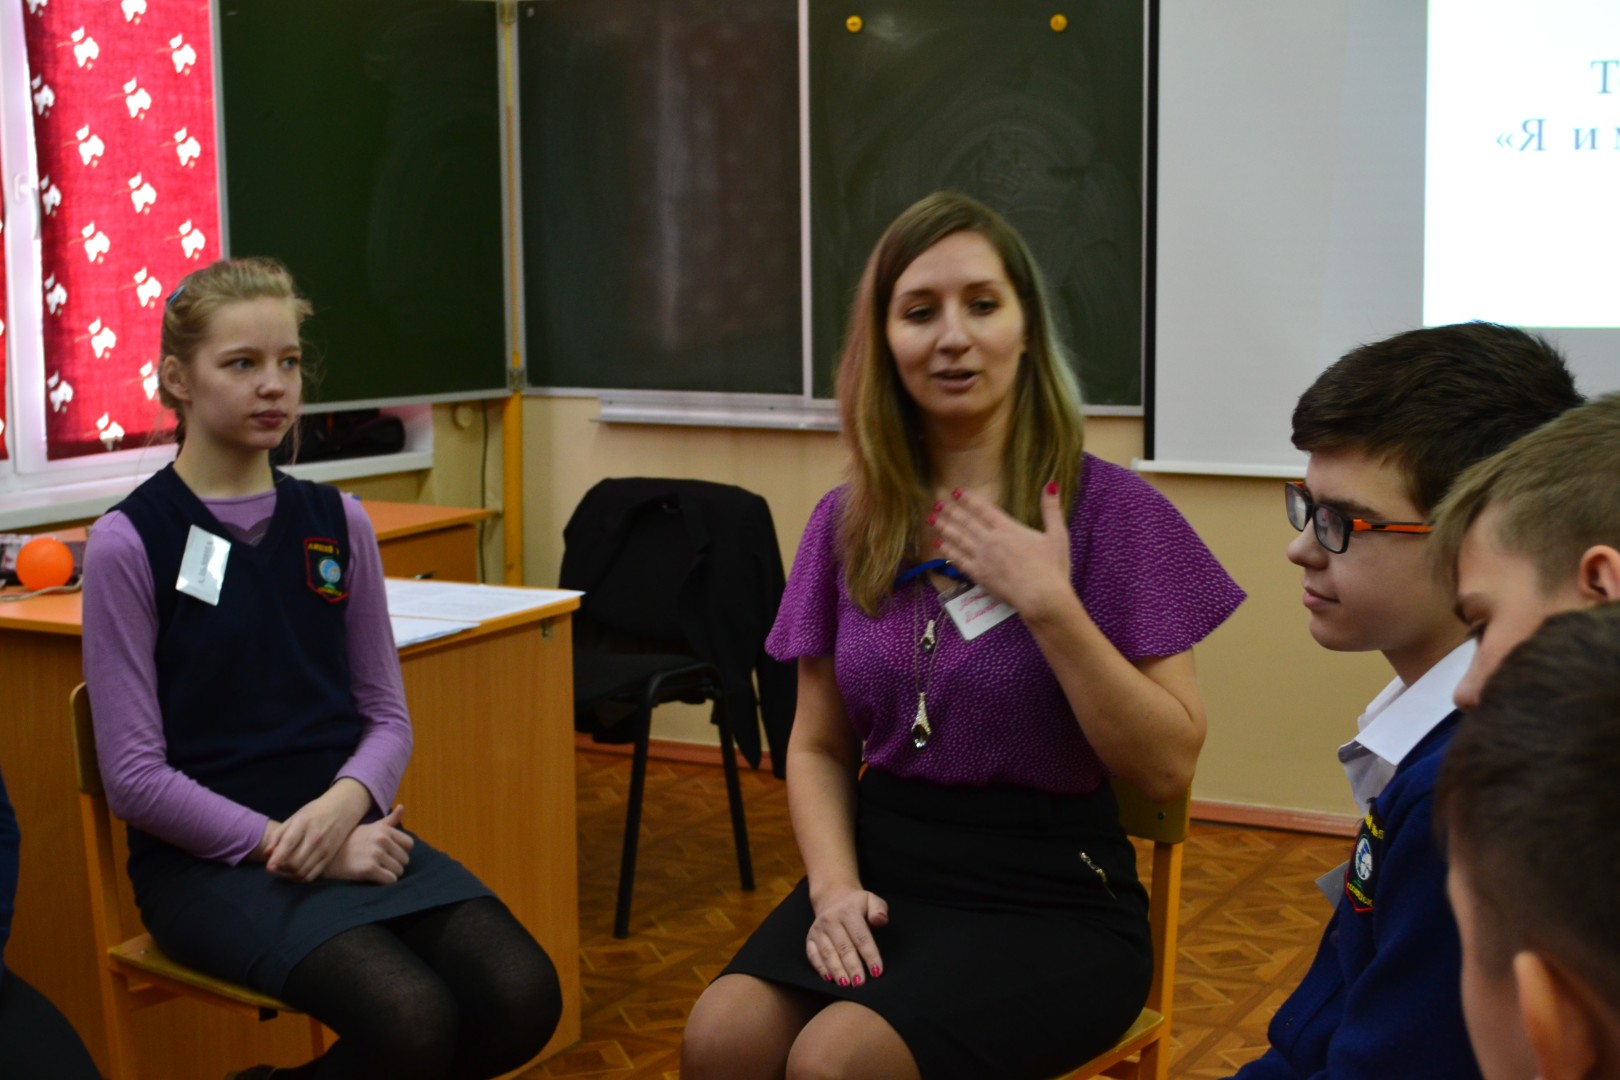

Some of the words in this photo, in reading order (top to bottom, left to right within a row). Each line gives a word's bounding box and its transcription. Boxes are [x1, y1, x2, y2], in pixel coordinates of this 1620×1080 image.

[1590, 60, 1620, 94] Т
[1495, 118, 1547, 152] «Я
[1572, 127, 1599, 151] и
